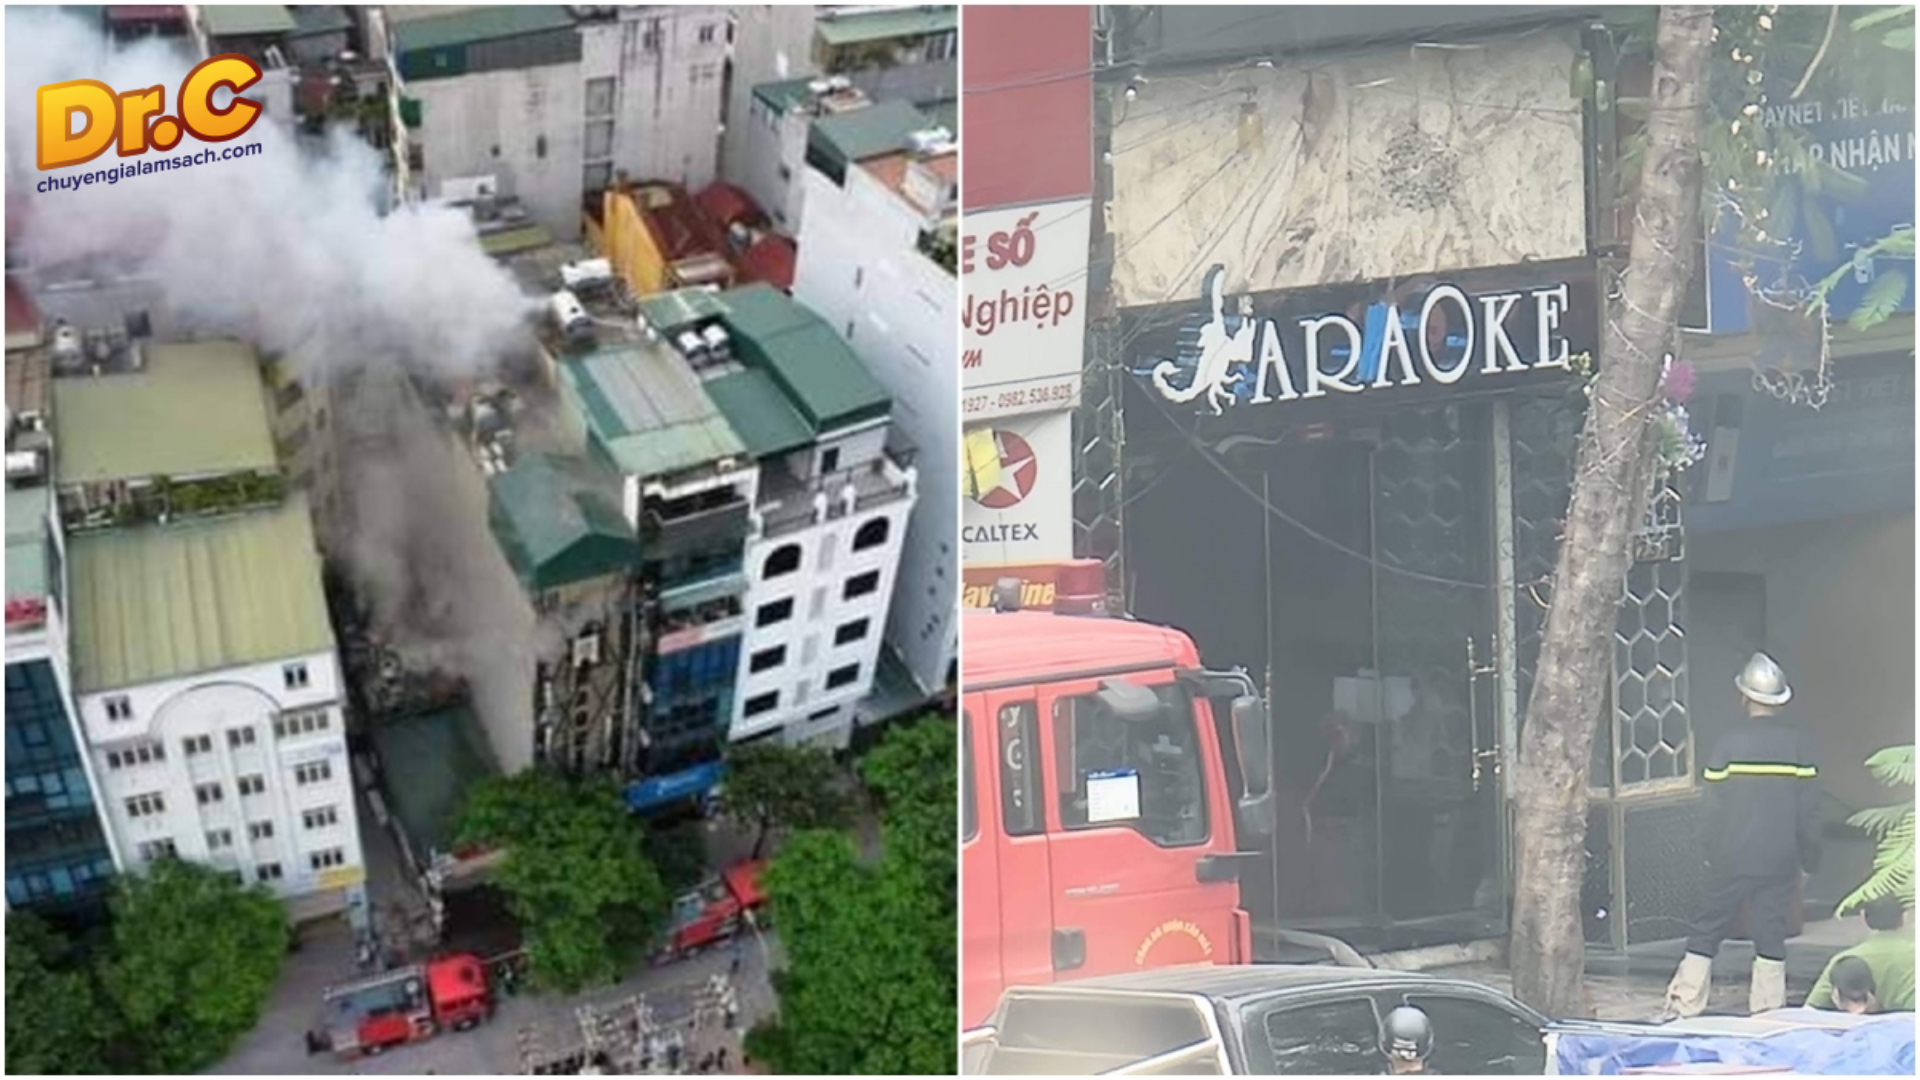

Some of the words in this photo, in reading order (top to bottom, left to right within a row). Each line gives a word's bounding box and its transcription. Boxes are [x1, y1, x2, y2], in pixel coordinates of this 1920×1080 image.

[1830, 128, 1901, 171] NHẬN
[986, 211, 1039, 270] SỐ
[963, 523, 1039, 543] CALTEX
